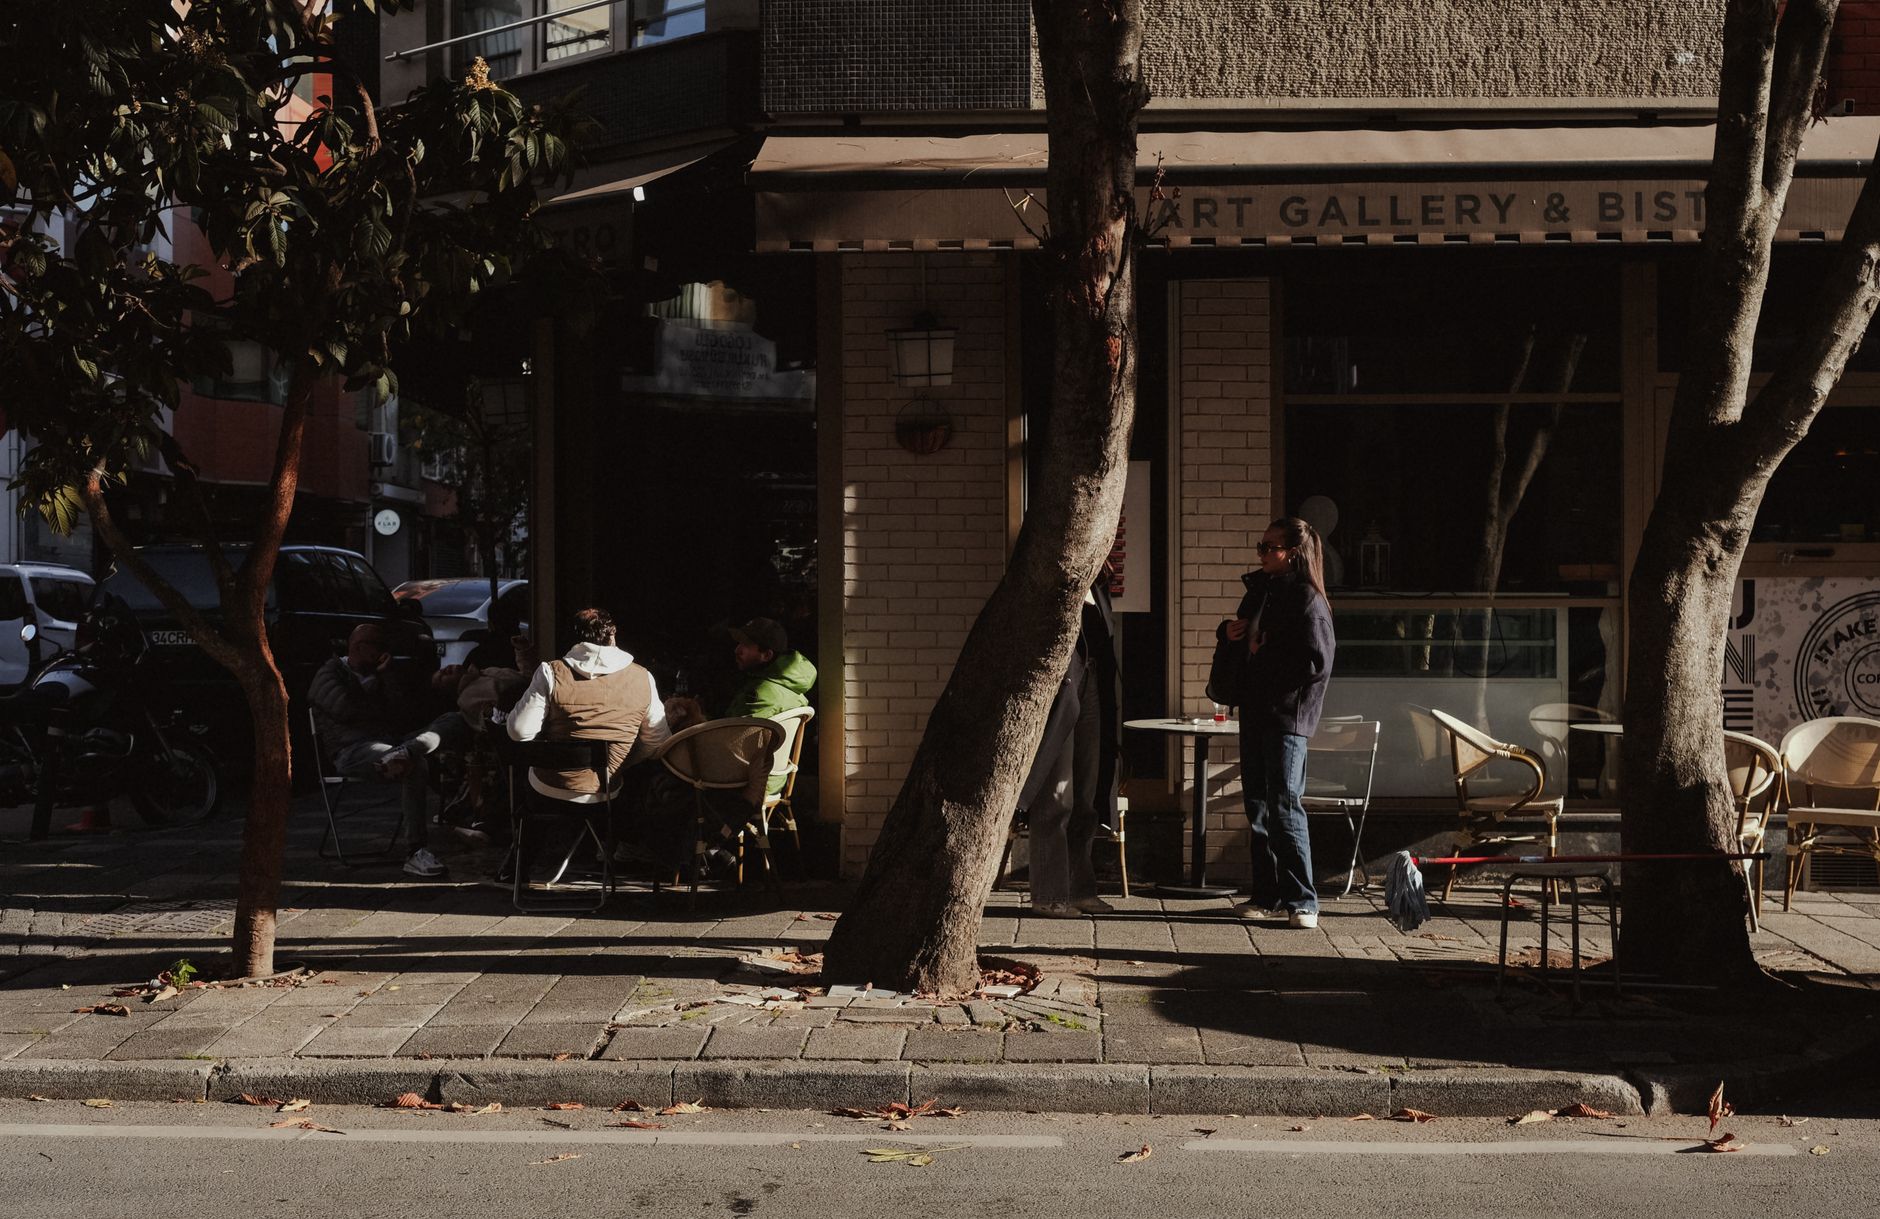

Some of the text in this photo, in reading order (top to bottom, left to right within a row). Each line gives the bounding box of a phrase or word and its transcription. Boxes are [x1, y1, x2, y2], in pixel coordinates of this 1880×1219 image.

[1157, 197, 1252, 228] ART
[1279, 192, 1516, 227] GALLERY
[1543, 192, 1571, 223] &
